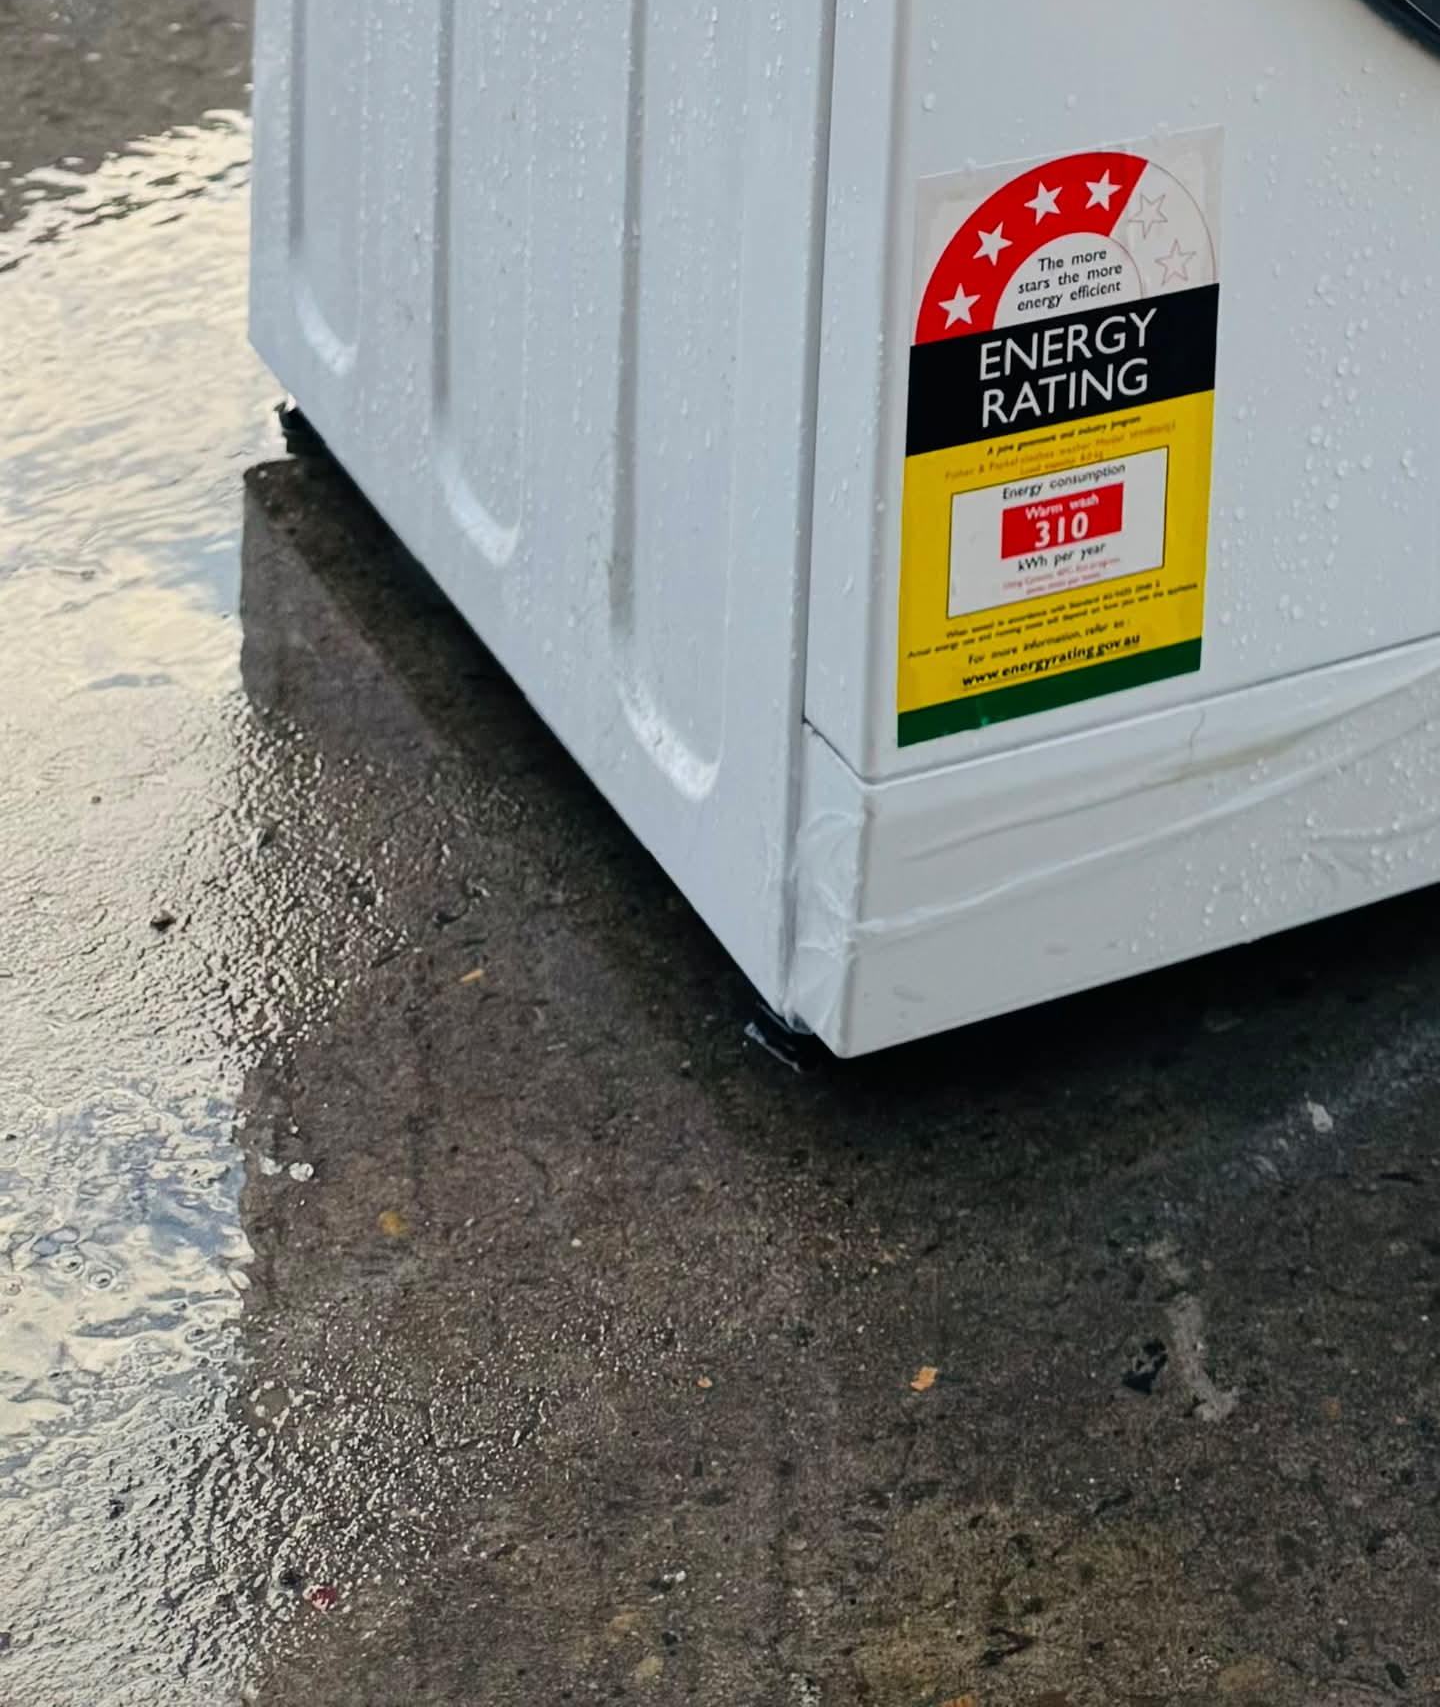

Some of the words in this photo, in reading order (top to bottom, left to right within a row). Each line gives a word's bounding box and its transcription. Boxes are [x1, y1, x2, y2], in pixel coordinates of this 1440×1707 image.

[1038, 256, 1064, 272] The
[1071, 250, 1107, 265] more
[1018, 278, 1050, 294] stars
[1058, 271, 1080, 286] the
[1087, 264, 1122, 280] more
[1017, 293, 1063, 312] energy
[1069, 281, 1121, 301] efficient
[979, 307, 1158, 381] ENERGY
[982, 357, 1148, 428] RATING
[1002, 482, 1044, 500] Energy
[1049, 464, 1126, 490] consumption
[1025, 503, 1064, 521] Warm
[1069, 492, 1100, 510] wash
[1034, 511, 1089, 549] 310
[1018, 555, 1048, 572] kWh
[1054, 550, 1075, 567] per
[1080, 543, 1106, 561] year
